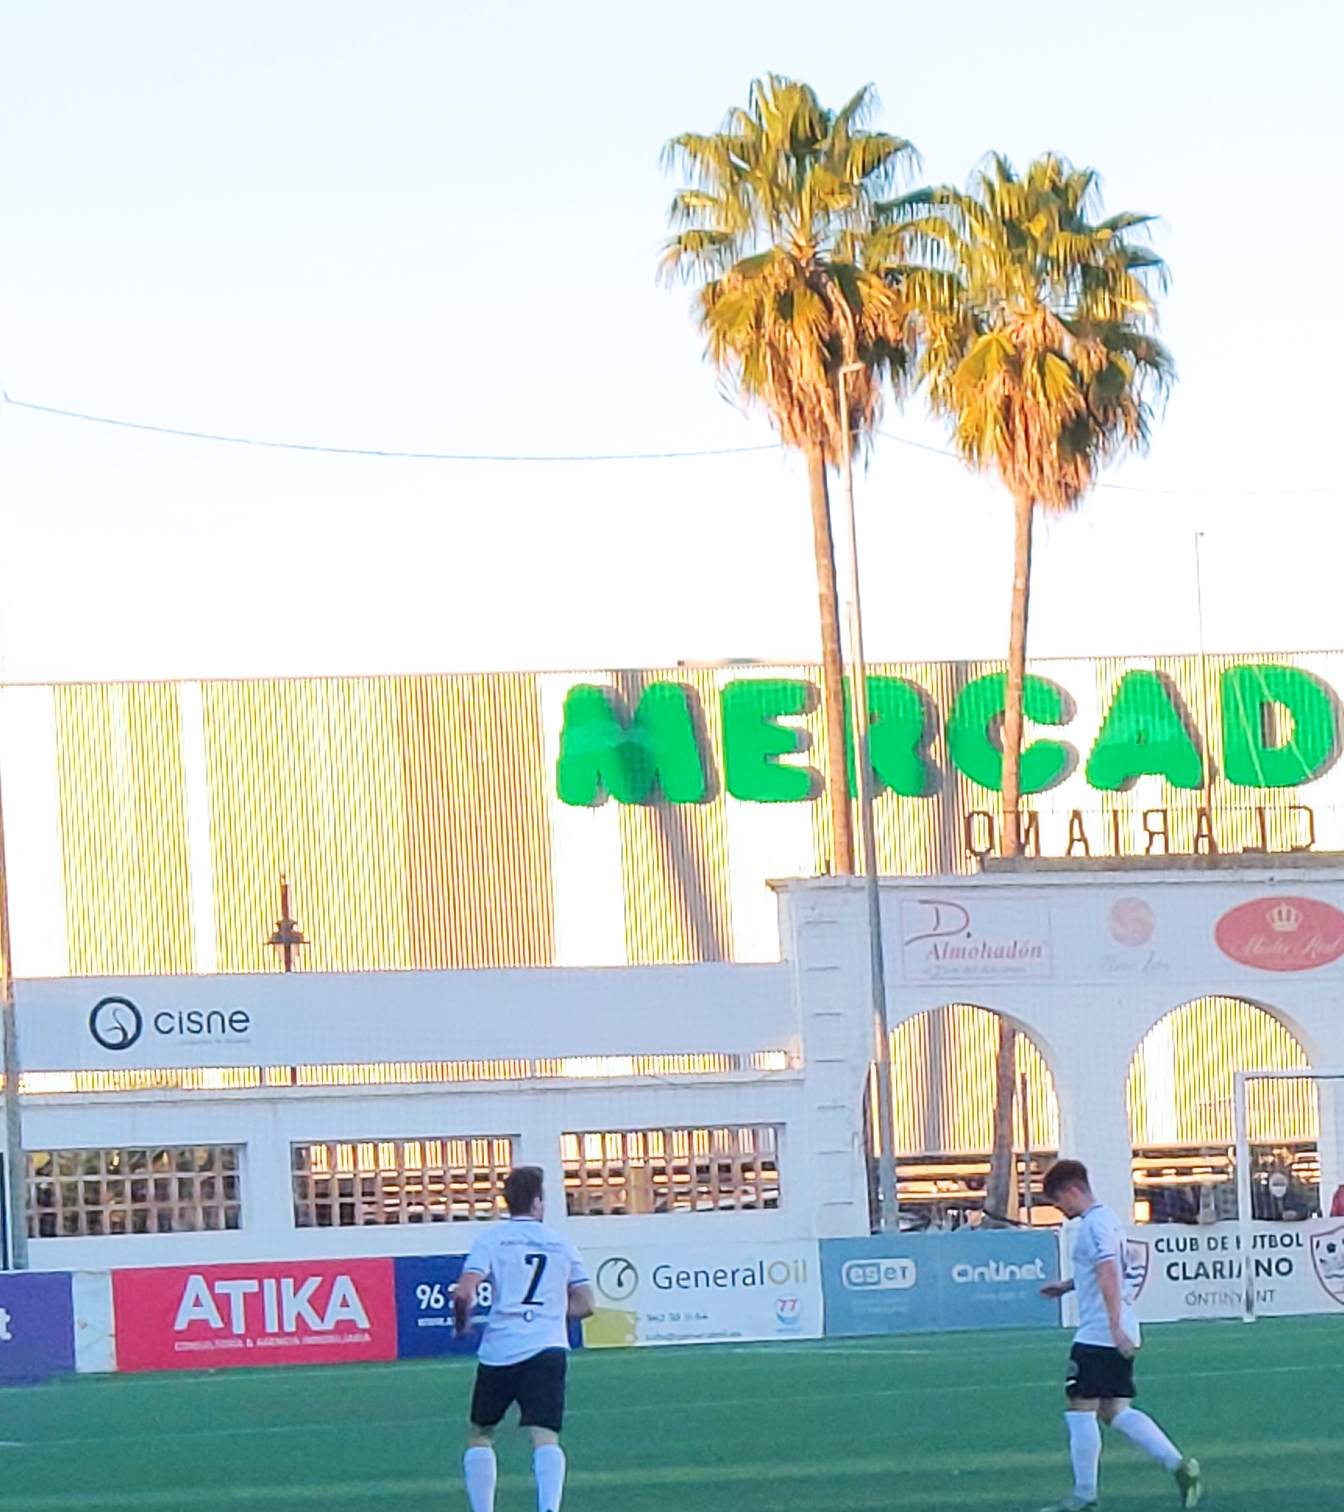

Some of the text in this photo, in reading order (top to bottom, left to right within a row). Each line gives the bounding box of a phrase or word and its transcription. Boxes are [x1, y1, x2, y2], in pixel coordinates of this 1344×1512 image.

[926, 939, 1043, 961] Almohadón
[154, 1009, 250, 1035] cisne
[1155, 1238, 1200, 1253] CLUB
[1207, 1236, 1229, 1251] DE
[174, 1275, 371, 1335] ATIKA
[416, 1283, 445, 1310] 96
